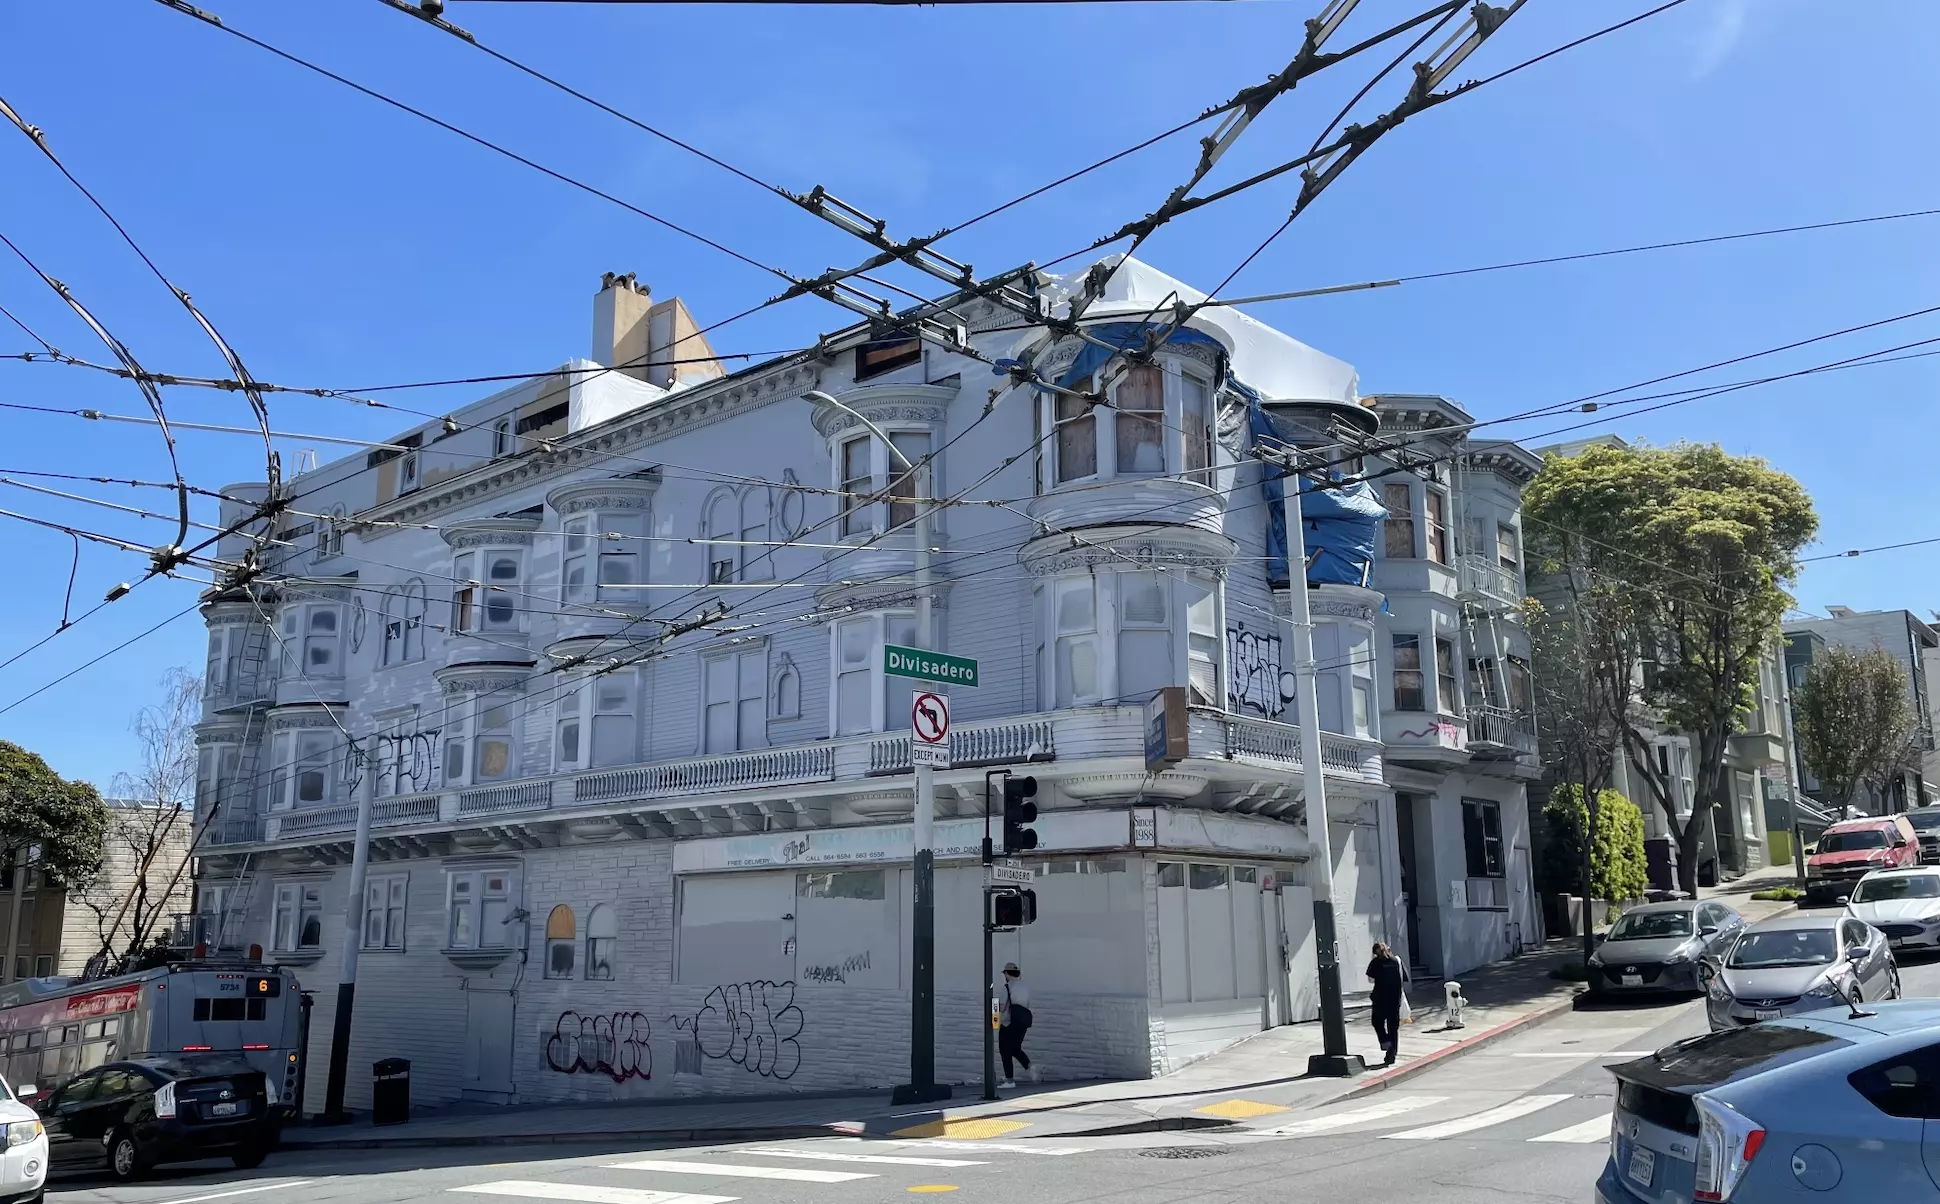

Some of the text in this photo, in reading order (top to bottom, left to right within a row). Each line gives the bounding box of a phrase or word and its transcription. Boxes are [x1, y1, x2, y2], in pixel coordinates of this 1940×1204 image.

[889, 652, 974, 680] Divisadero
[914, 749, 949, 763] EXCEPT MUNI
[1133, 815, 1154, 827] Since
[1135, 829, 1155, 841] 1988
[946, 846, 961, 854] AND
[997, 868, 1031, 881] DIVISADERO
[259, 979, 268, 992] 6
[1451, 1008, 1460, 1016] 12
